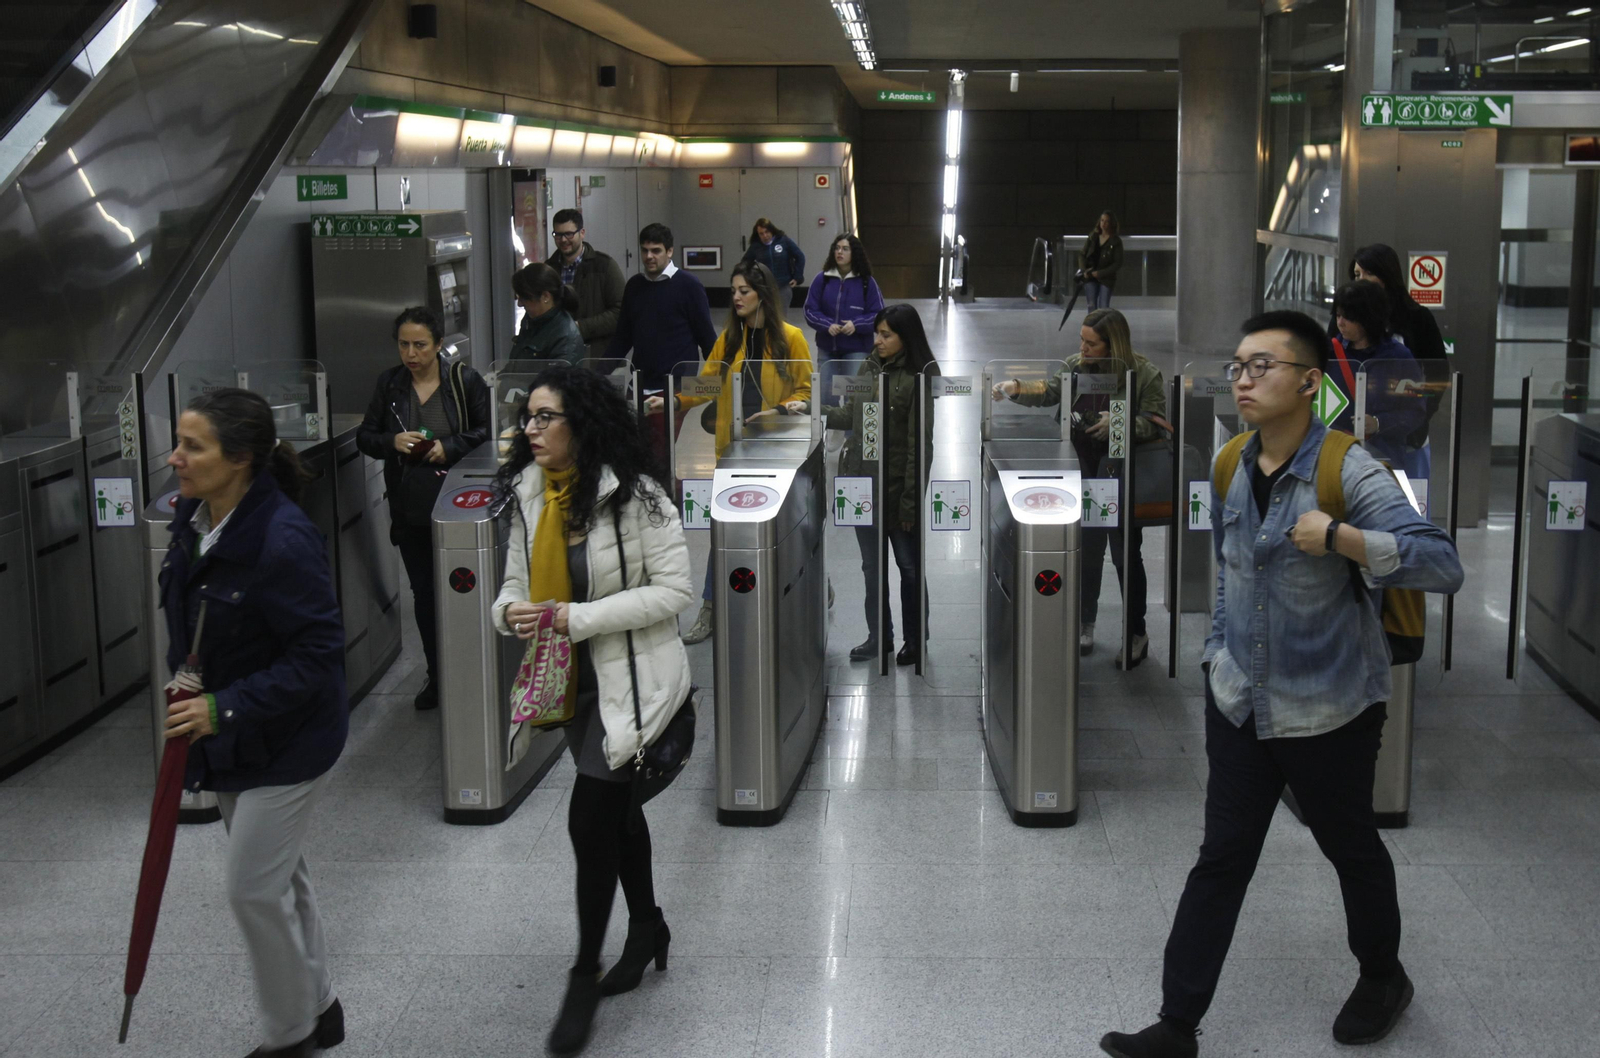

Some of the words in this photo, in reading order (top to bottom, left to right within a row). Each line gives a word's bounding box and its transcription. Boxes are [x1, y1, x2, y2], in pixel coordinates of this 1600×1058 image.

[888, 92, 924, 100] Andenes
[465, 136, 488, 152] Puerta
[312, 180, 338, 197] Billetes
[695, 384, 721, 392] metro
